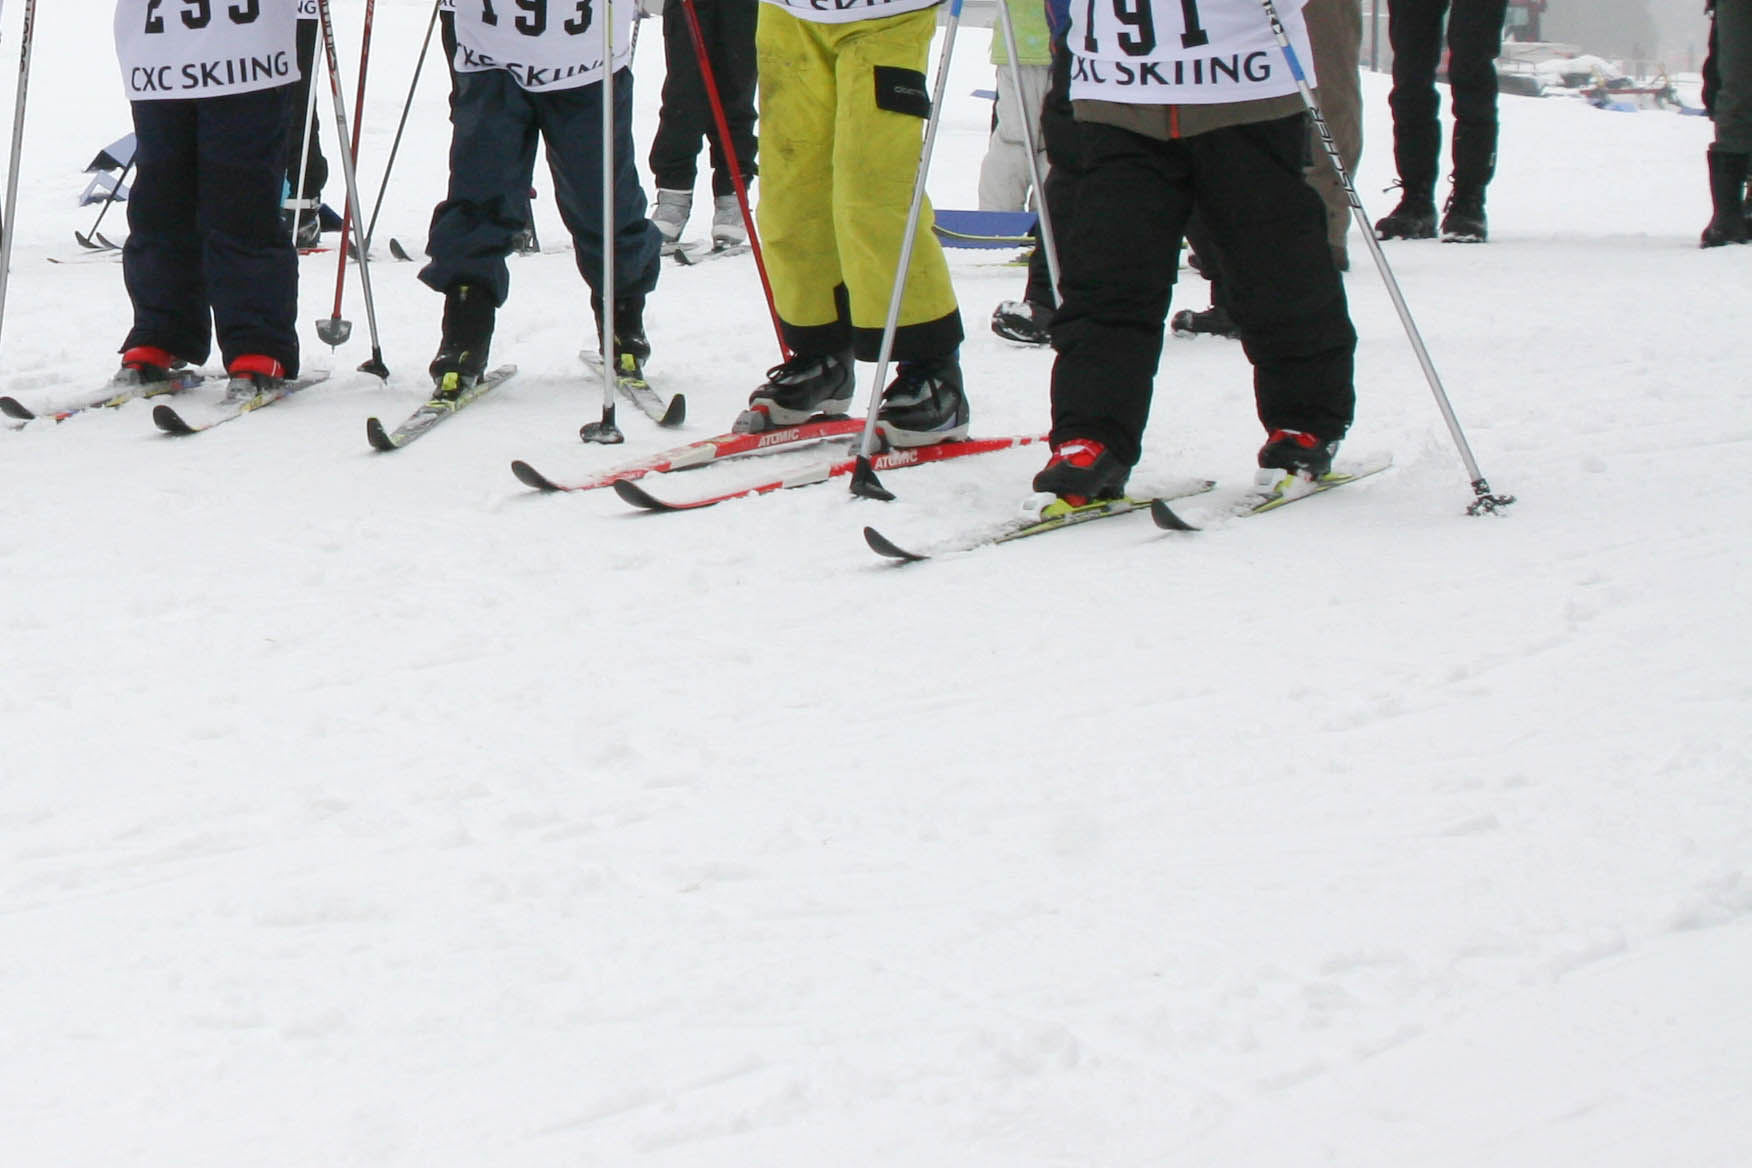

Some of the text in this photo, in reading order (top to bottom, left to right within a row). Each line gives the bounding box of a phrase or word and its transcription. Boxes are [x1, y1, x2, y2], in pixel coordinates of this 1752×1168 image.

[131, 51, 289, 92] CXC SKIING
[1115, 51, 1271, 86] SKIING
[1308, 106, 1362, 210] FISCHER
[758, 429, 799, 448] ATOMIC
[875, 451, 918, 470] ATOMIC
